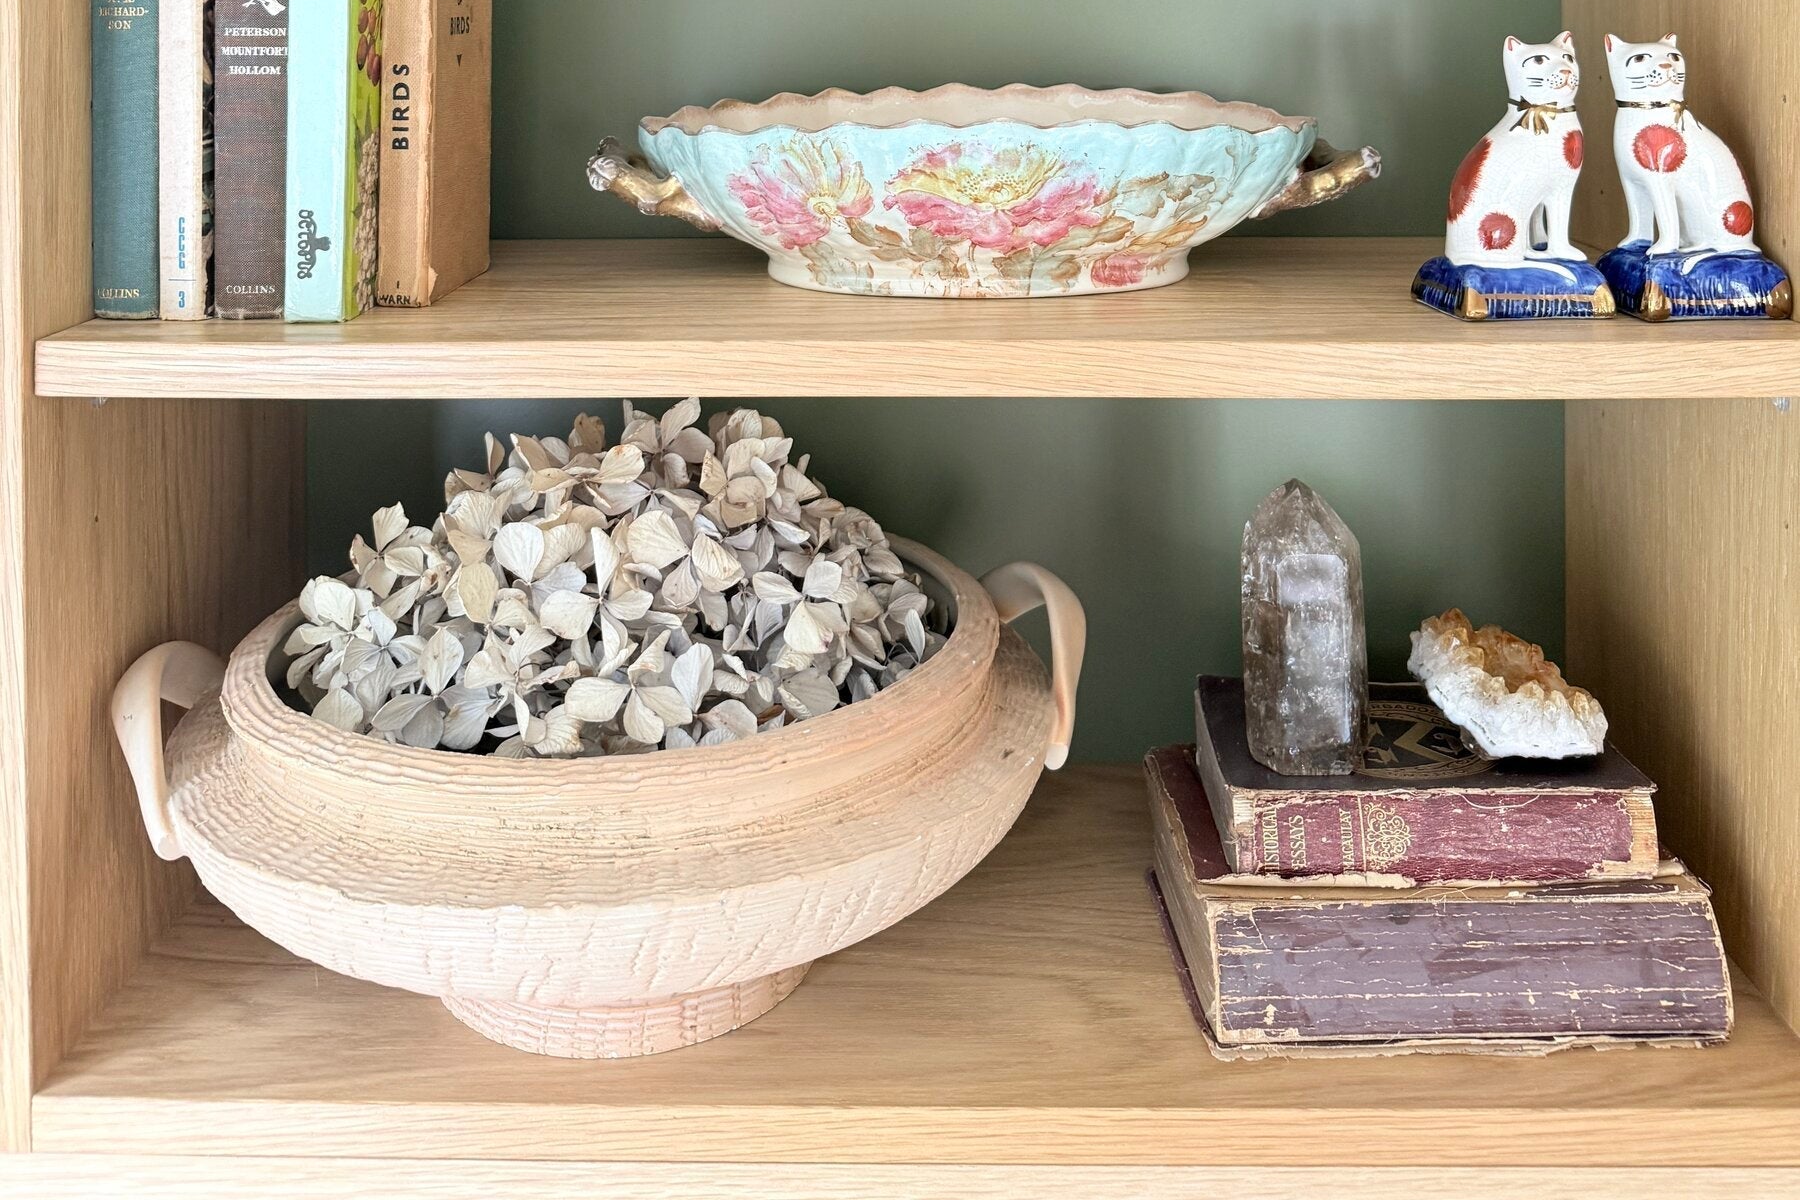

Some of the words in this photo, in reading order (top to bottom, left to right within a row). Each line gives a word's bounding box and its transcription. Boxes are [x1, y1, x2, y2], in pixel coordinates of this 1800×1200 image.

[108, 20, 132, 30] SON
[224, 27, 287, 37] PETERSON
[450, 17, 470, 35] BIRDS
[229, 65, 281, 75] HOLLOM
[392, 64, 410, 150] BIRDS
[226, 285, 275, 294] COLLINS
[178, 291, 185, 308] 3
[1262, 807, 1280, 875] HISTORICAL
[1289, 814, 1306, 870] ESSAYS
[1338, 808, 1355, 873] MACAULAY
